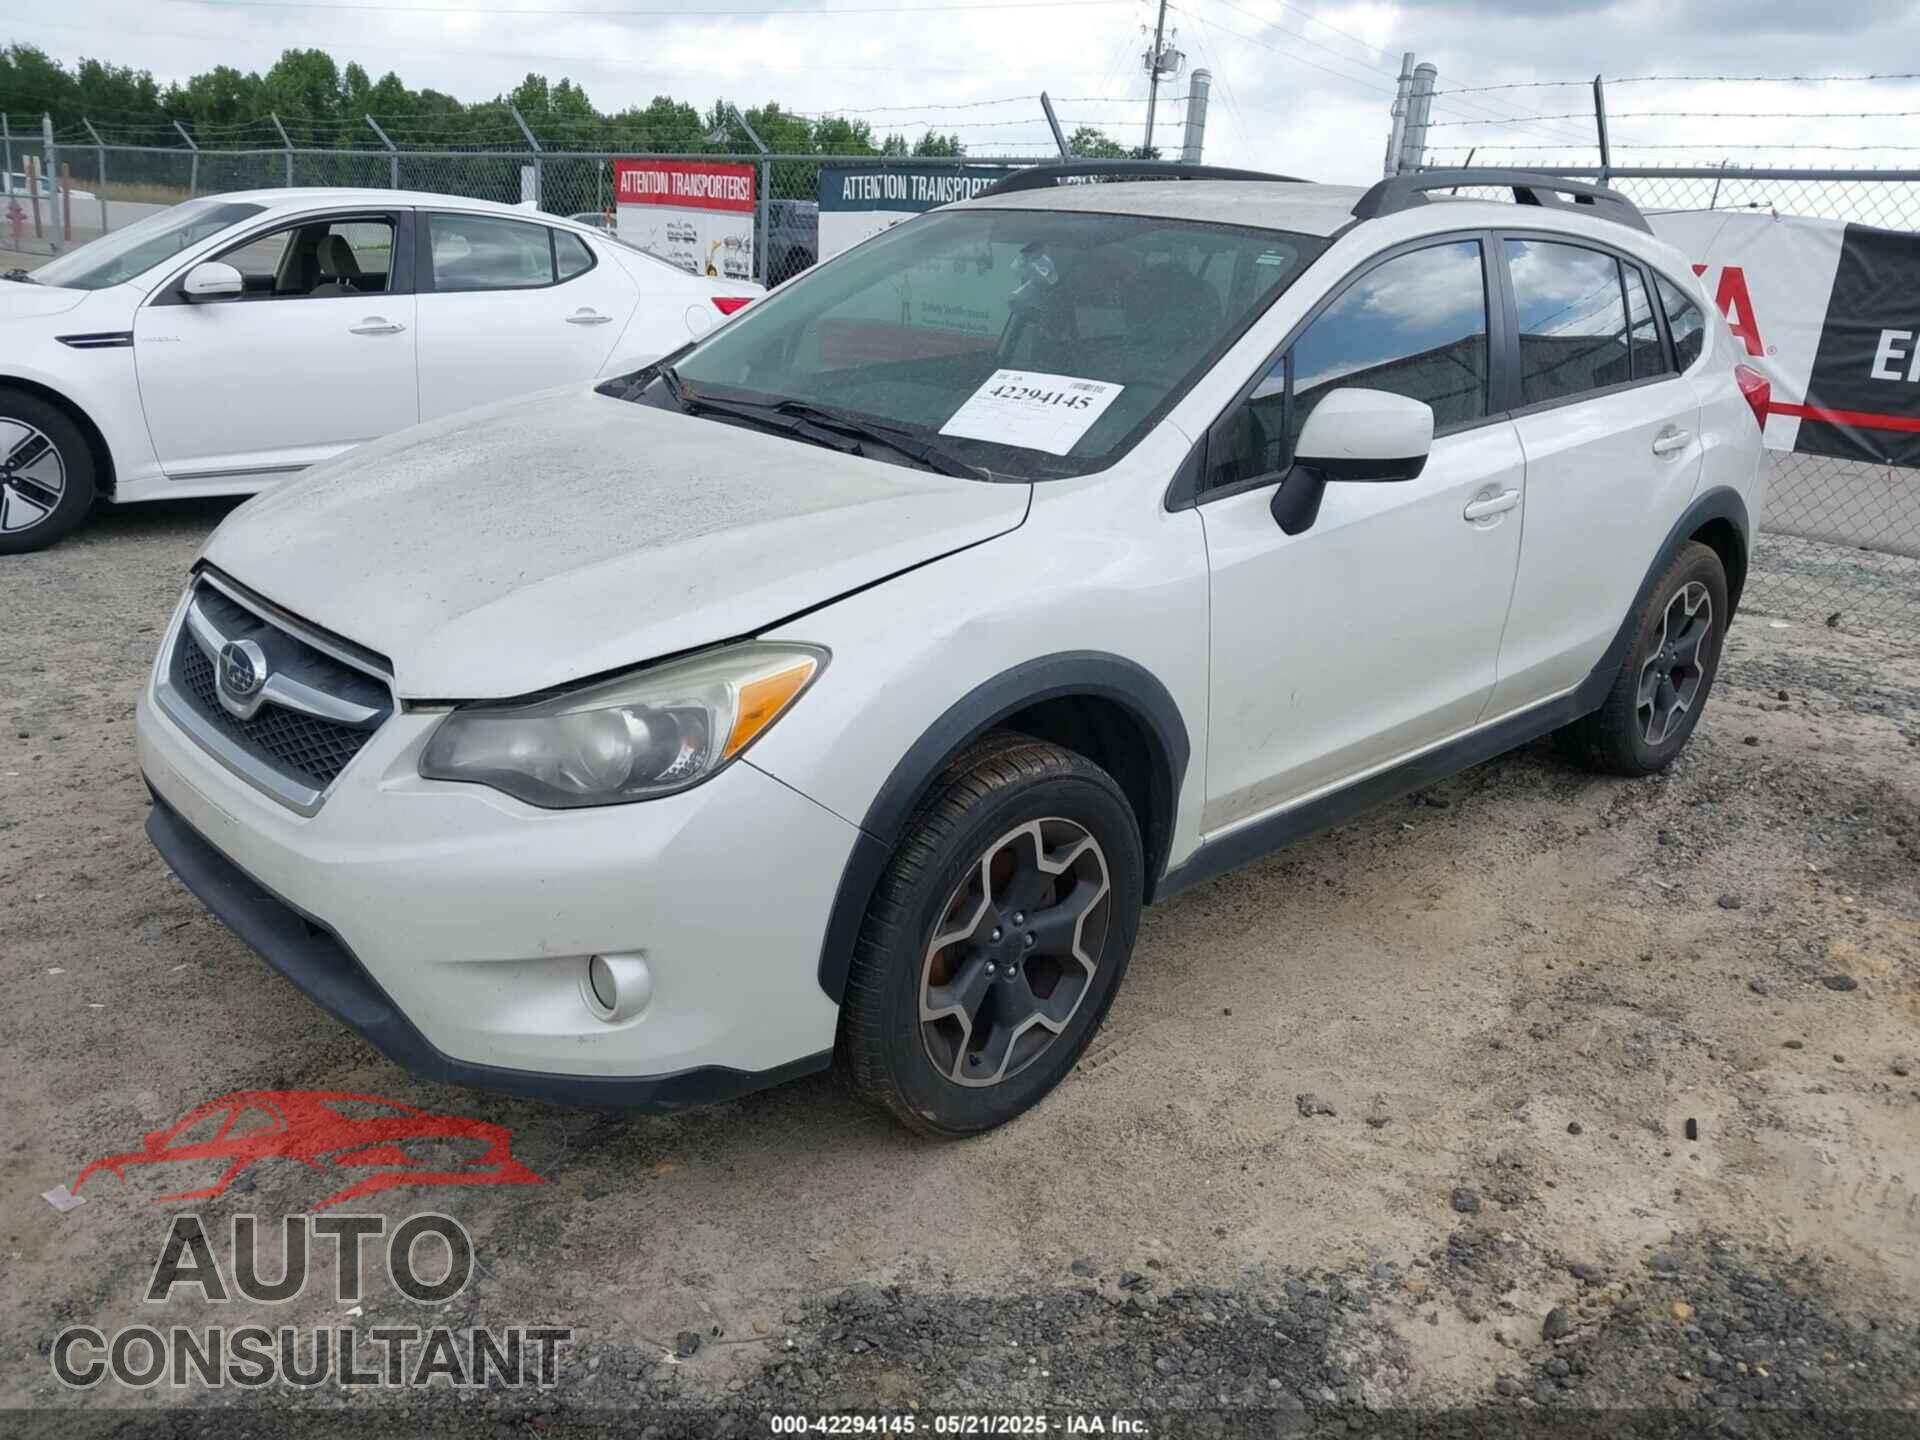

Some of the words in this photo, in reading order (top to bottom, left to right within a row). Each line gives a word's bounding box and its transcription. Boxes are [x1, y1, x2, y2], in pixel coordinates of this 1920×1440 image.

[670, 171, 751, 201] TRANSPORTERS!
[842, 174, 907, 200] ATTENTION
[990, 385, 1093, 409] 42294145
